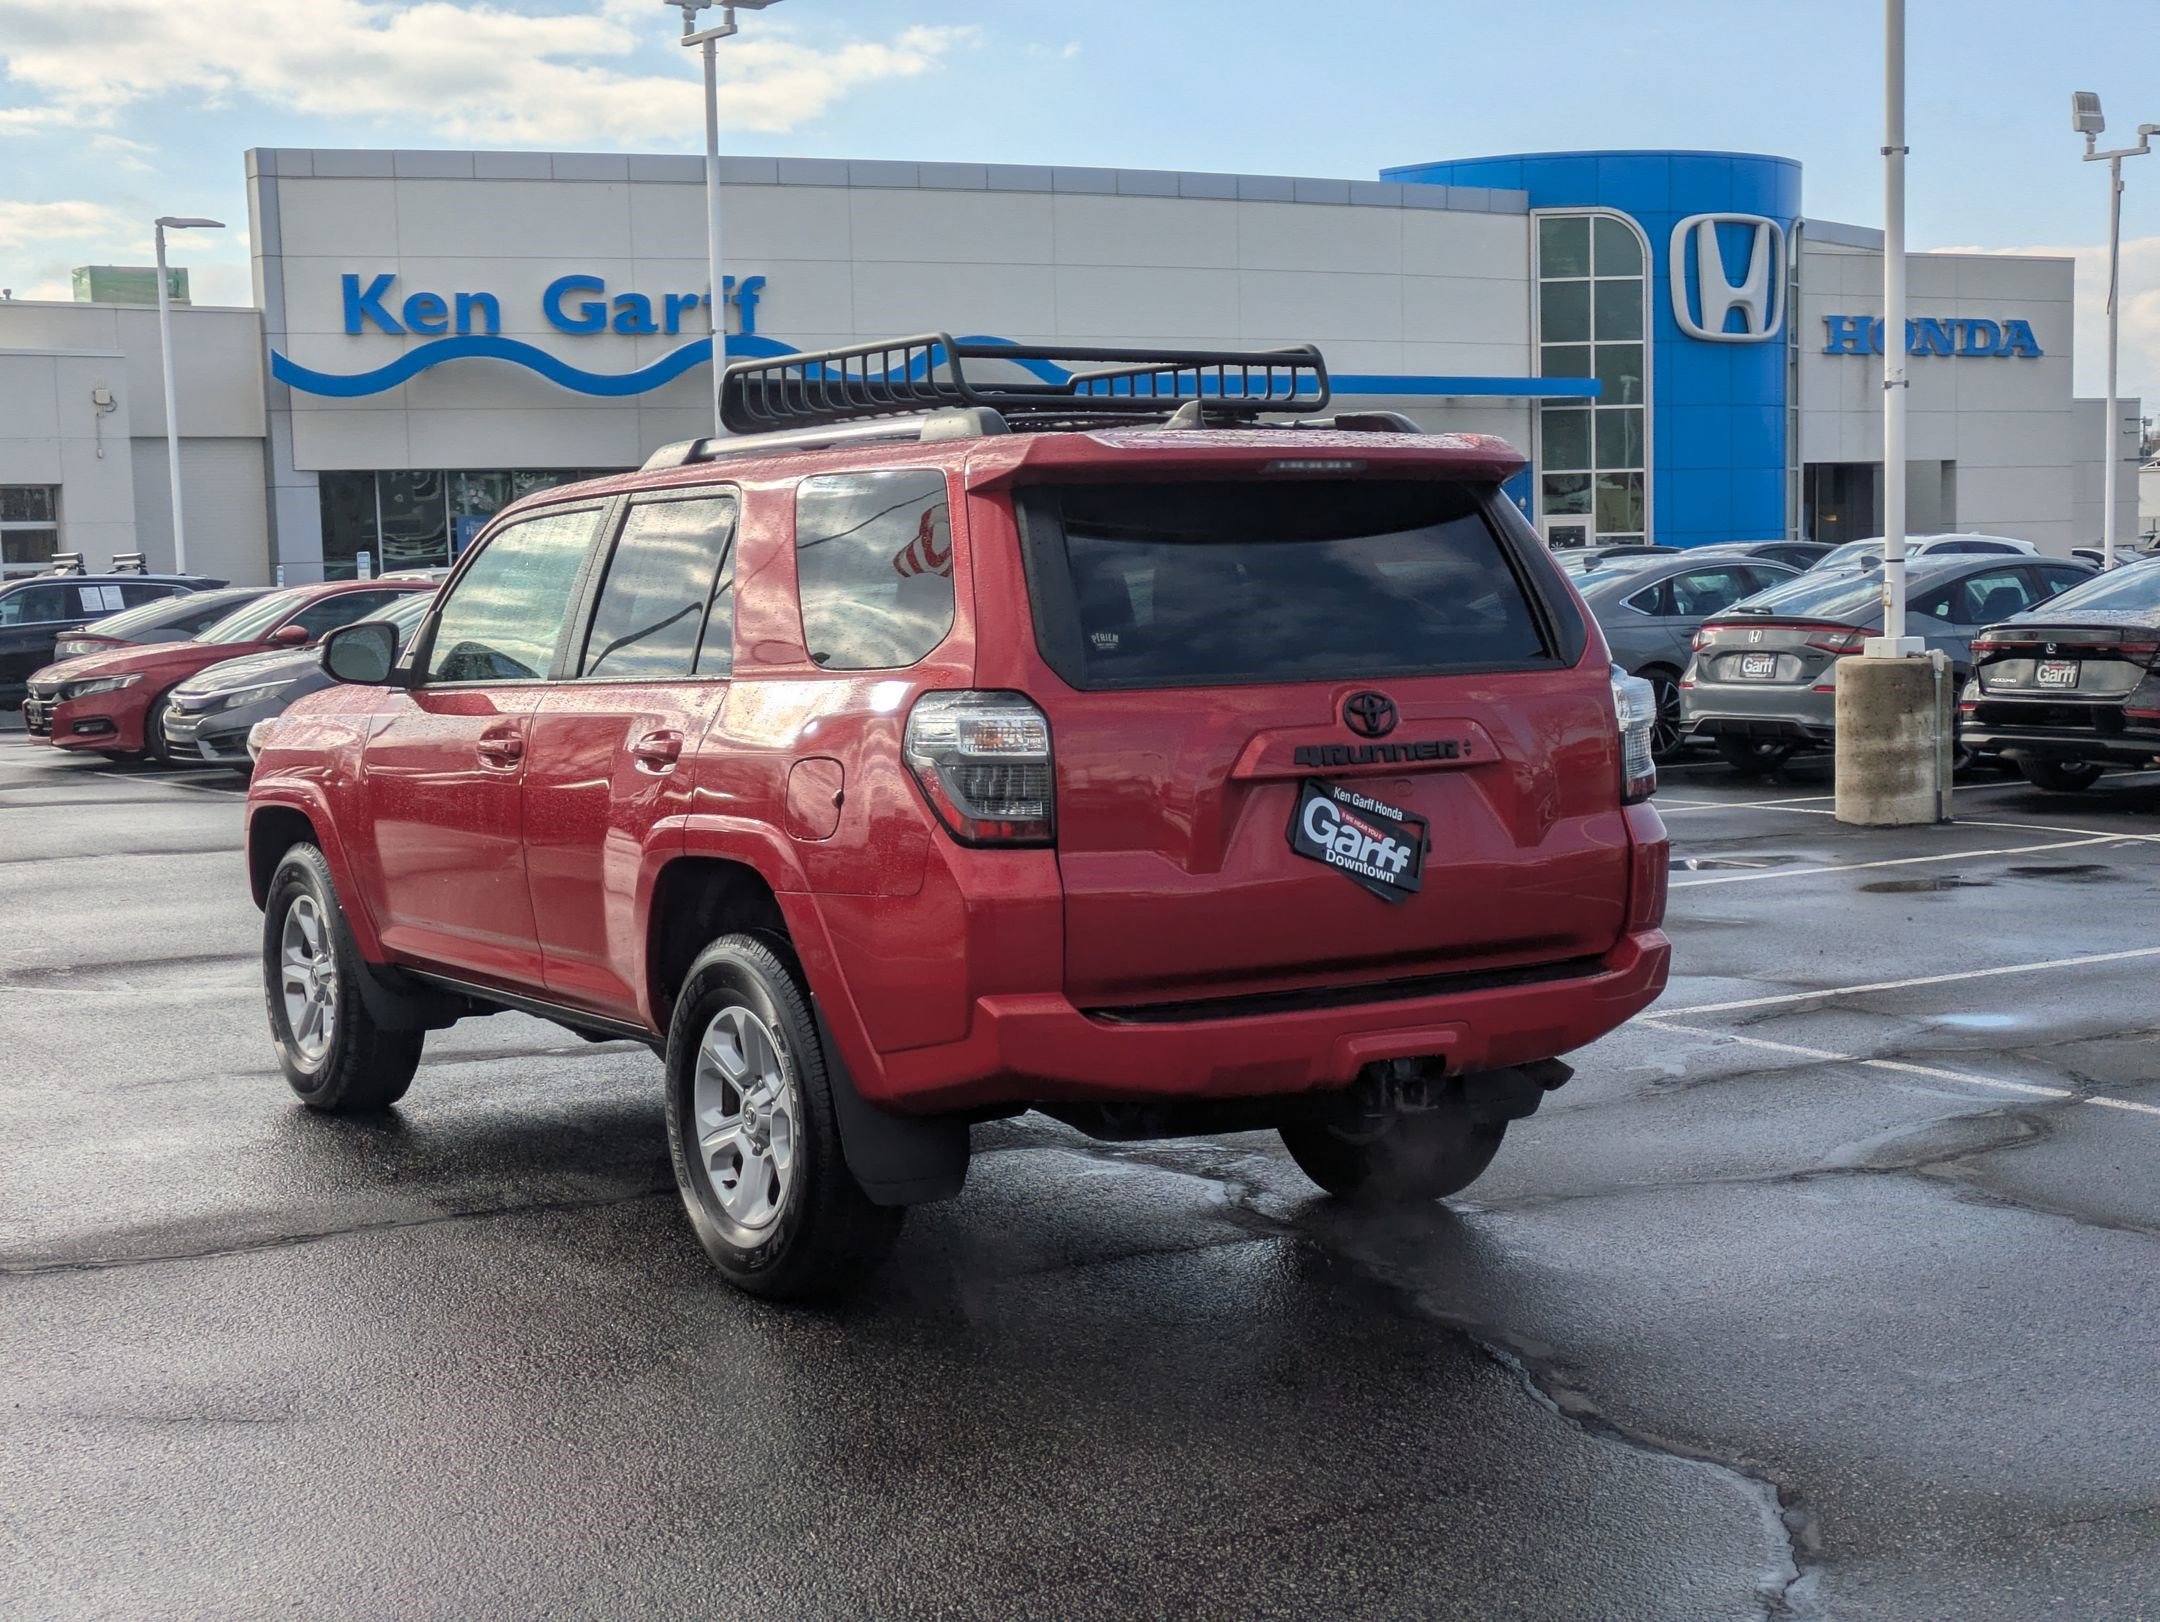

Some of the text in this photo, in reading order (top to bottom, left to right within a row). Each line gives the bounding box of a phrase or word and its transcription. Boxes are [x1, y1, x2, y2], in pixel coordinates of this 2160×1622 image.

[342, 273, 501, 335] Ken
[1743, 657, 1775, 673] Garff
[2037, 665, 2077, 683] Garff
[1294, 740, 1460, 767] 4RUNNER
[1333, 786, 1404, 821] Ken Garff Honda
[1303, 797, 1412, 873] Garff
[1325, 849, 1395, 884] Downtown
